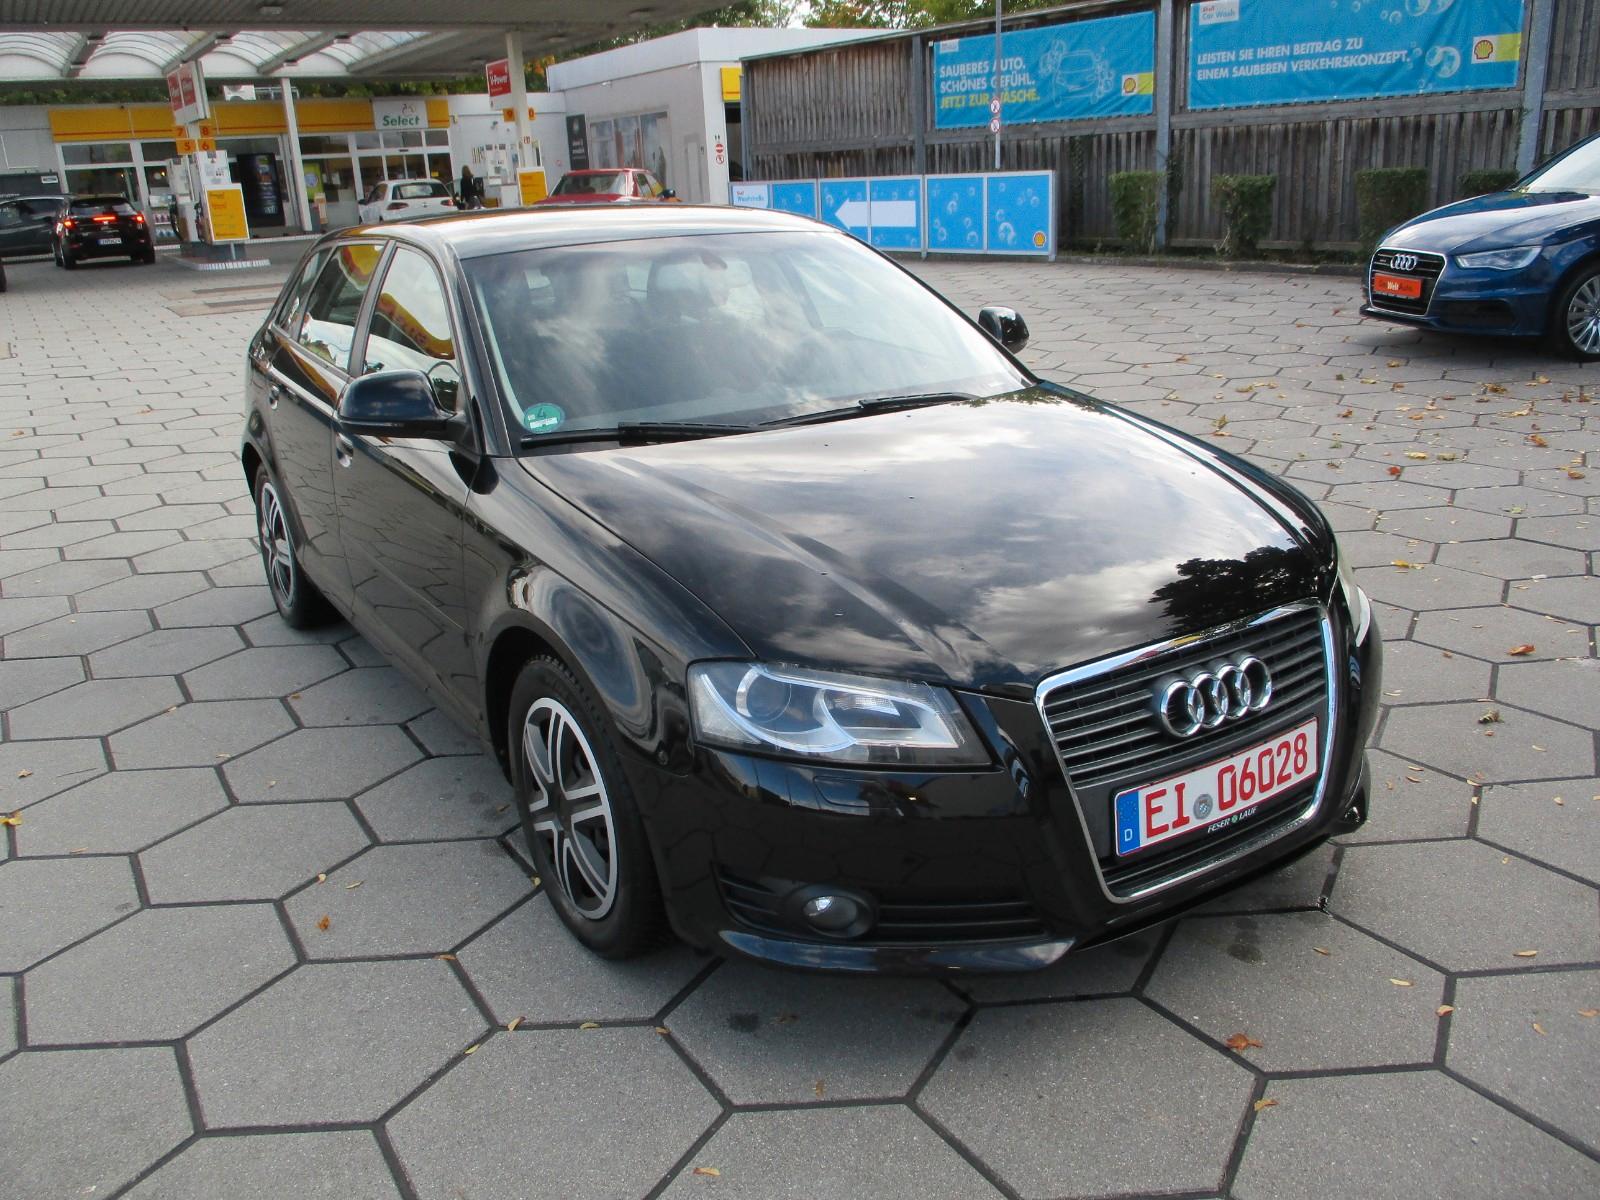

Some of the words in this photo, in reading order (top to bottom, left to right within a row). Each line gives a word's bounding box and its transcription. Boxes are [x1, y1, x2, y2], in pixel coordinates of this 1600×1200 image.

[1197, 51, 1236, 66] LEISTEN
[1238, 48, 1254, 62] SIE
[1257, 45, 1291, 59] IHREN
[1292, 39, 1342, 56] BEITRAG
[1345, 37, 1364, 51] ZU
[940, 61, 990, 78] SAUBERES
[1197, 66, 1230, 81] EINEM
[1231, 61, 1288, 78] SAUBEREN
[1291, 50, 1410, 72] VERKEHRSKONZEPT.
[940, 76, 987, 94] SCHÖNES
[940, 96, 966, 110] JETZT
[969, 92, 991, 107] ZUR
[993, 89, 1041, 104] ÄSCHE.
[382, 114, 420, 127] Select
[176, 127, 184, 137] 7
[201, 126, 209, 136] 8
[183, 141, 191, 151] 5
[201, 141, 210, 151] 6
[1124, 828, 1134, 842] D
[1145, 782, 1190, 839] EI
[1217, 732, 1309, 811] 06028
[1207, 818, 1231, 834] FESER
[1238, 806, 1259, 821] LAUF
